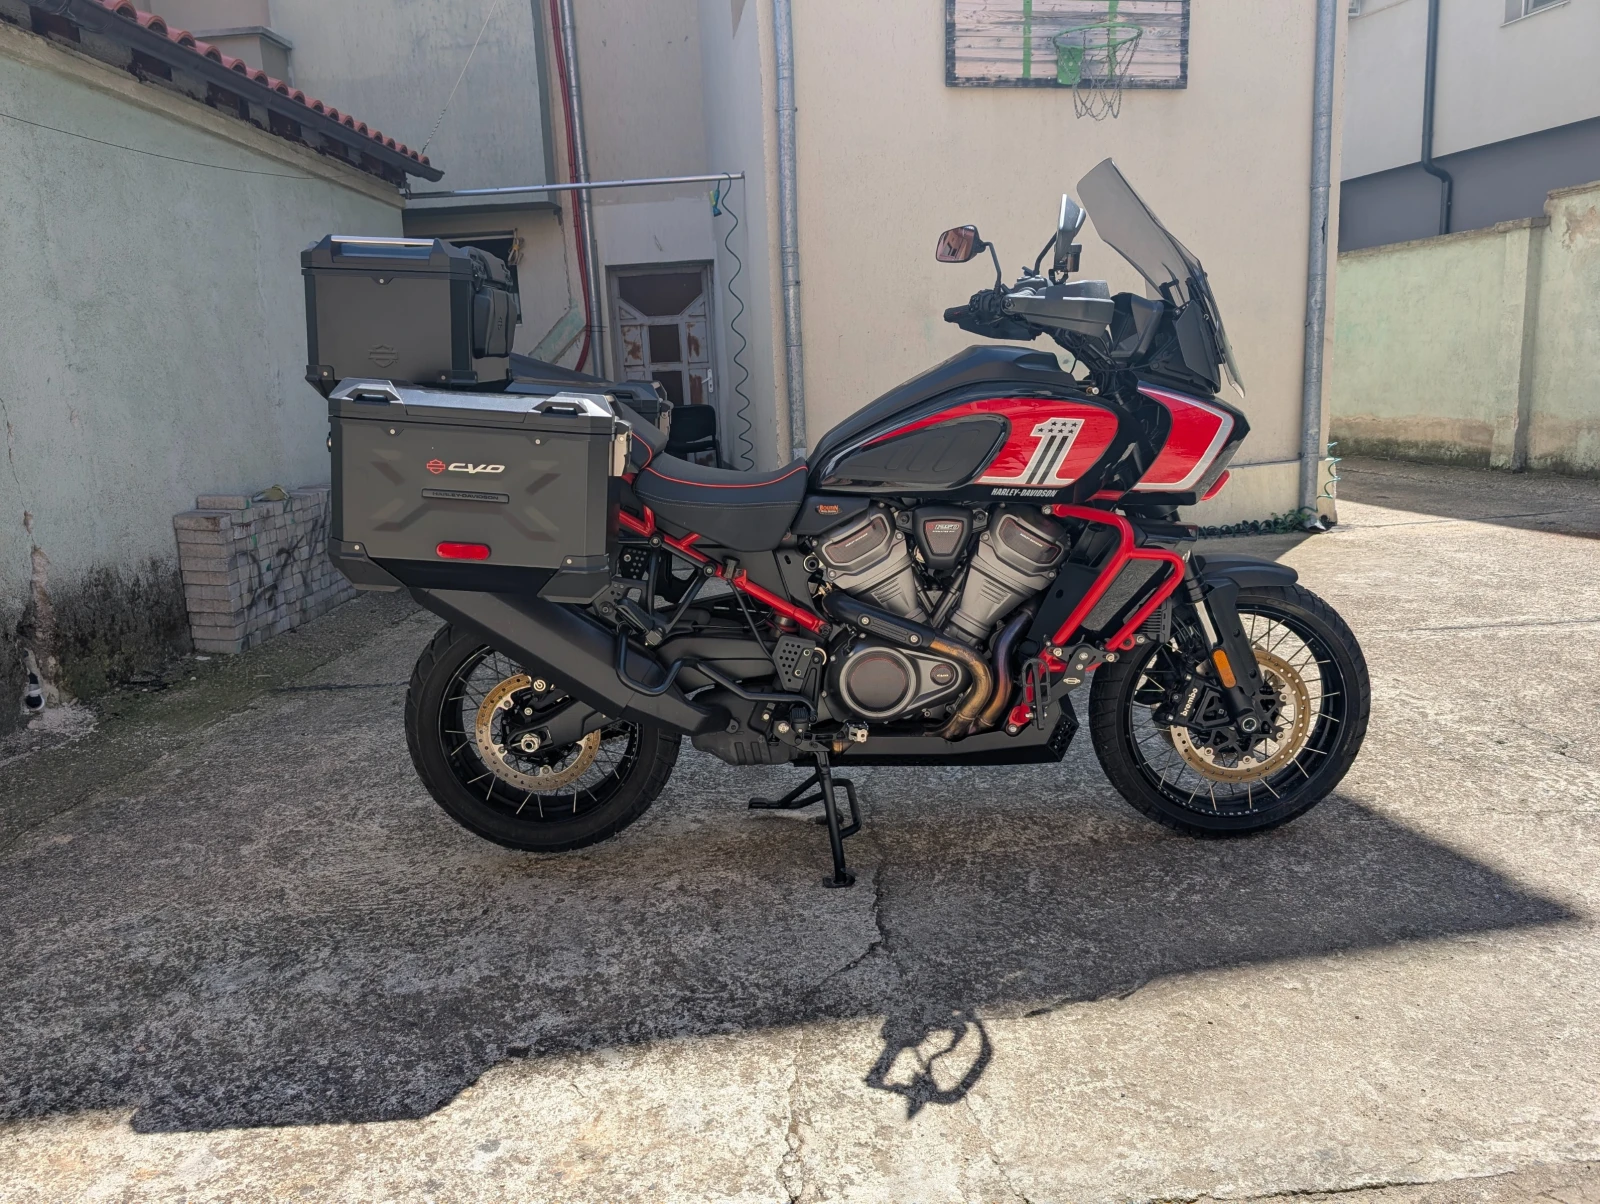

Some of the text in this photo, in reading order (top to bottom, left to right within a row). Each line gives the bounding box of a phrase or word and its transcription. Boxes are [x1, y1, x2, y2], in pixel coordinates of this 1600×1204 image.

[448, 463, 505, 473] CVO
[432, 491, 498, 500] HARLEY-DAVIDSON
[991, 487, 1059, 497] HARLEY-DAVIDSON
[1180, 688, 1198, 716] brembo
